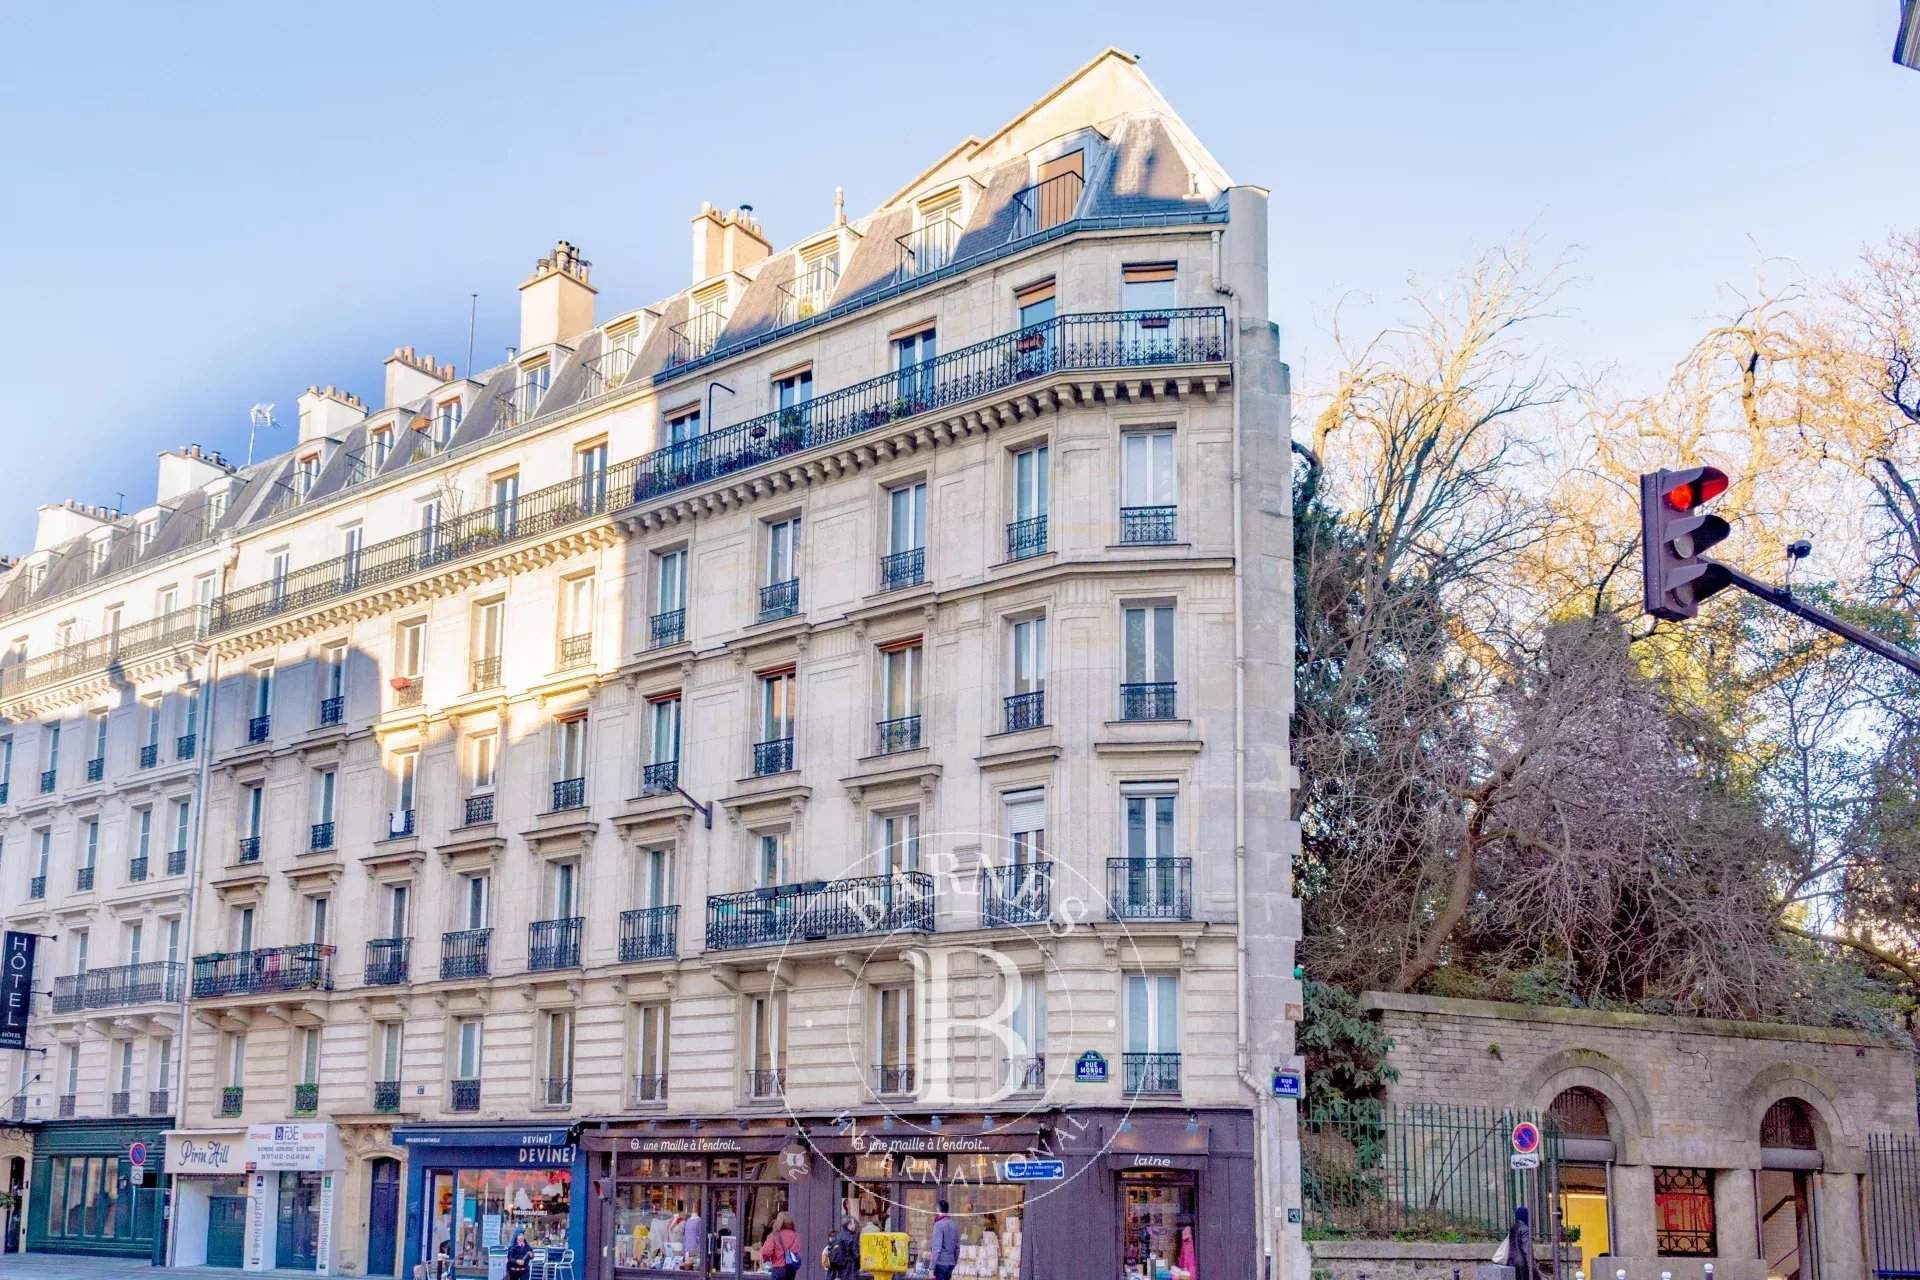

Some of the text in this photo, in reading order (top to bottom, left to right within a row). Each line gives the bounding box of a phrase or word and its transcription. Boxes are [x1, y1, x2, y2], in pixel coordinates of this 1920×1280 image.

[8, 935, 28, 1026] HÔTEL
[643, 1142, 659, 1151] une
[690, 1139, 697, 1151] à
[869, 1142, 888, 1151] une
[927, 1139, 934, 1151] à
[1134, 1154, 1171, 1166] laine
